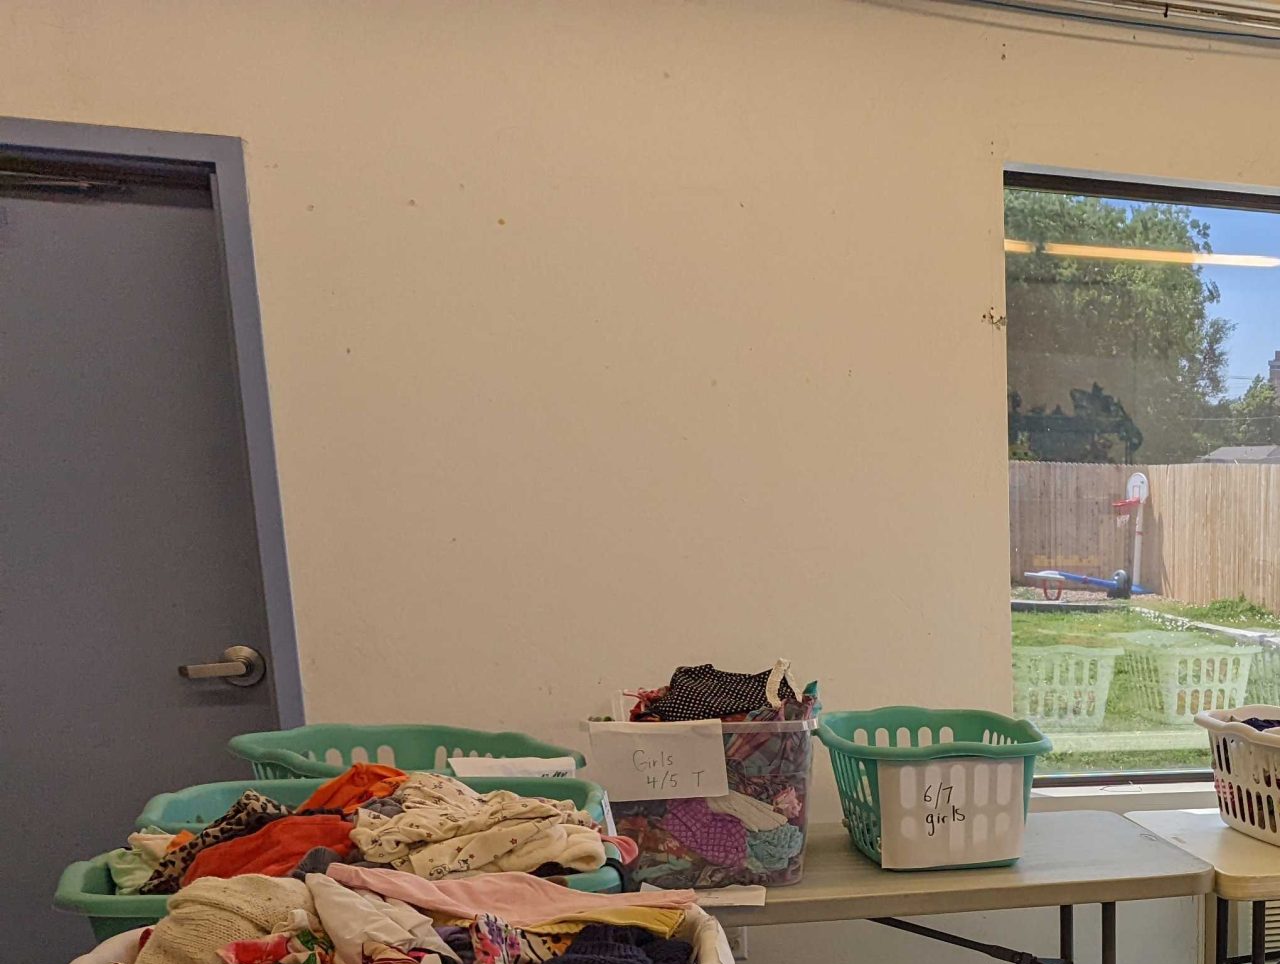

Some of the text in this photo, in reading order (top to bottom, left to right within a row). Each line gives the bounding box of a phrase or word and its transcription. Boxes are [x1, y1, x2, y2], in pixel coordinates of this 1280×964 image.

[632, 749, 674, 773] Girls
[646, 770, 705, 790] 4/5 T
[923, 781, 954, 810] 6/7
[925, 804, 966, 837] girls
